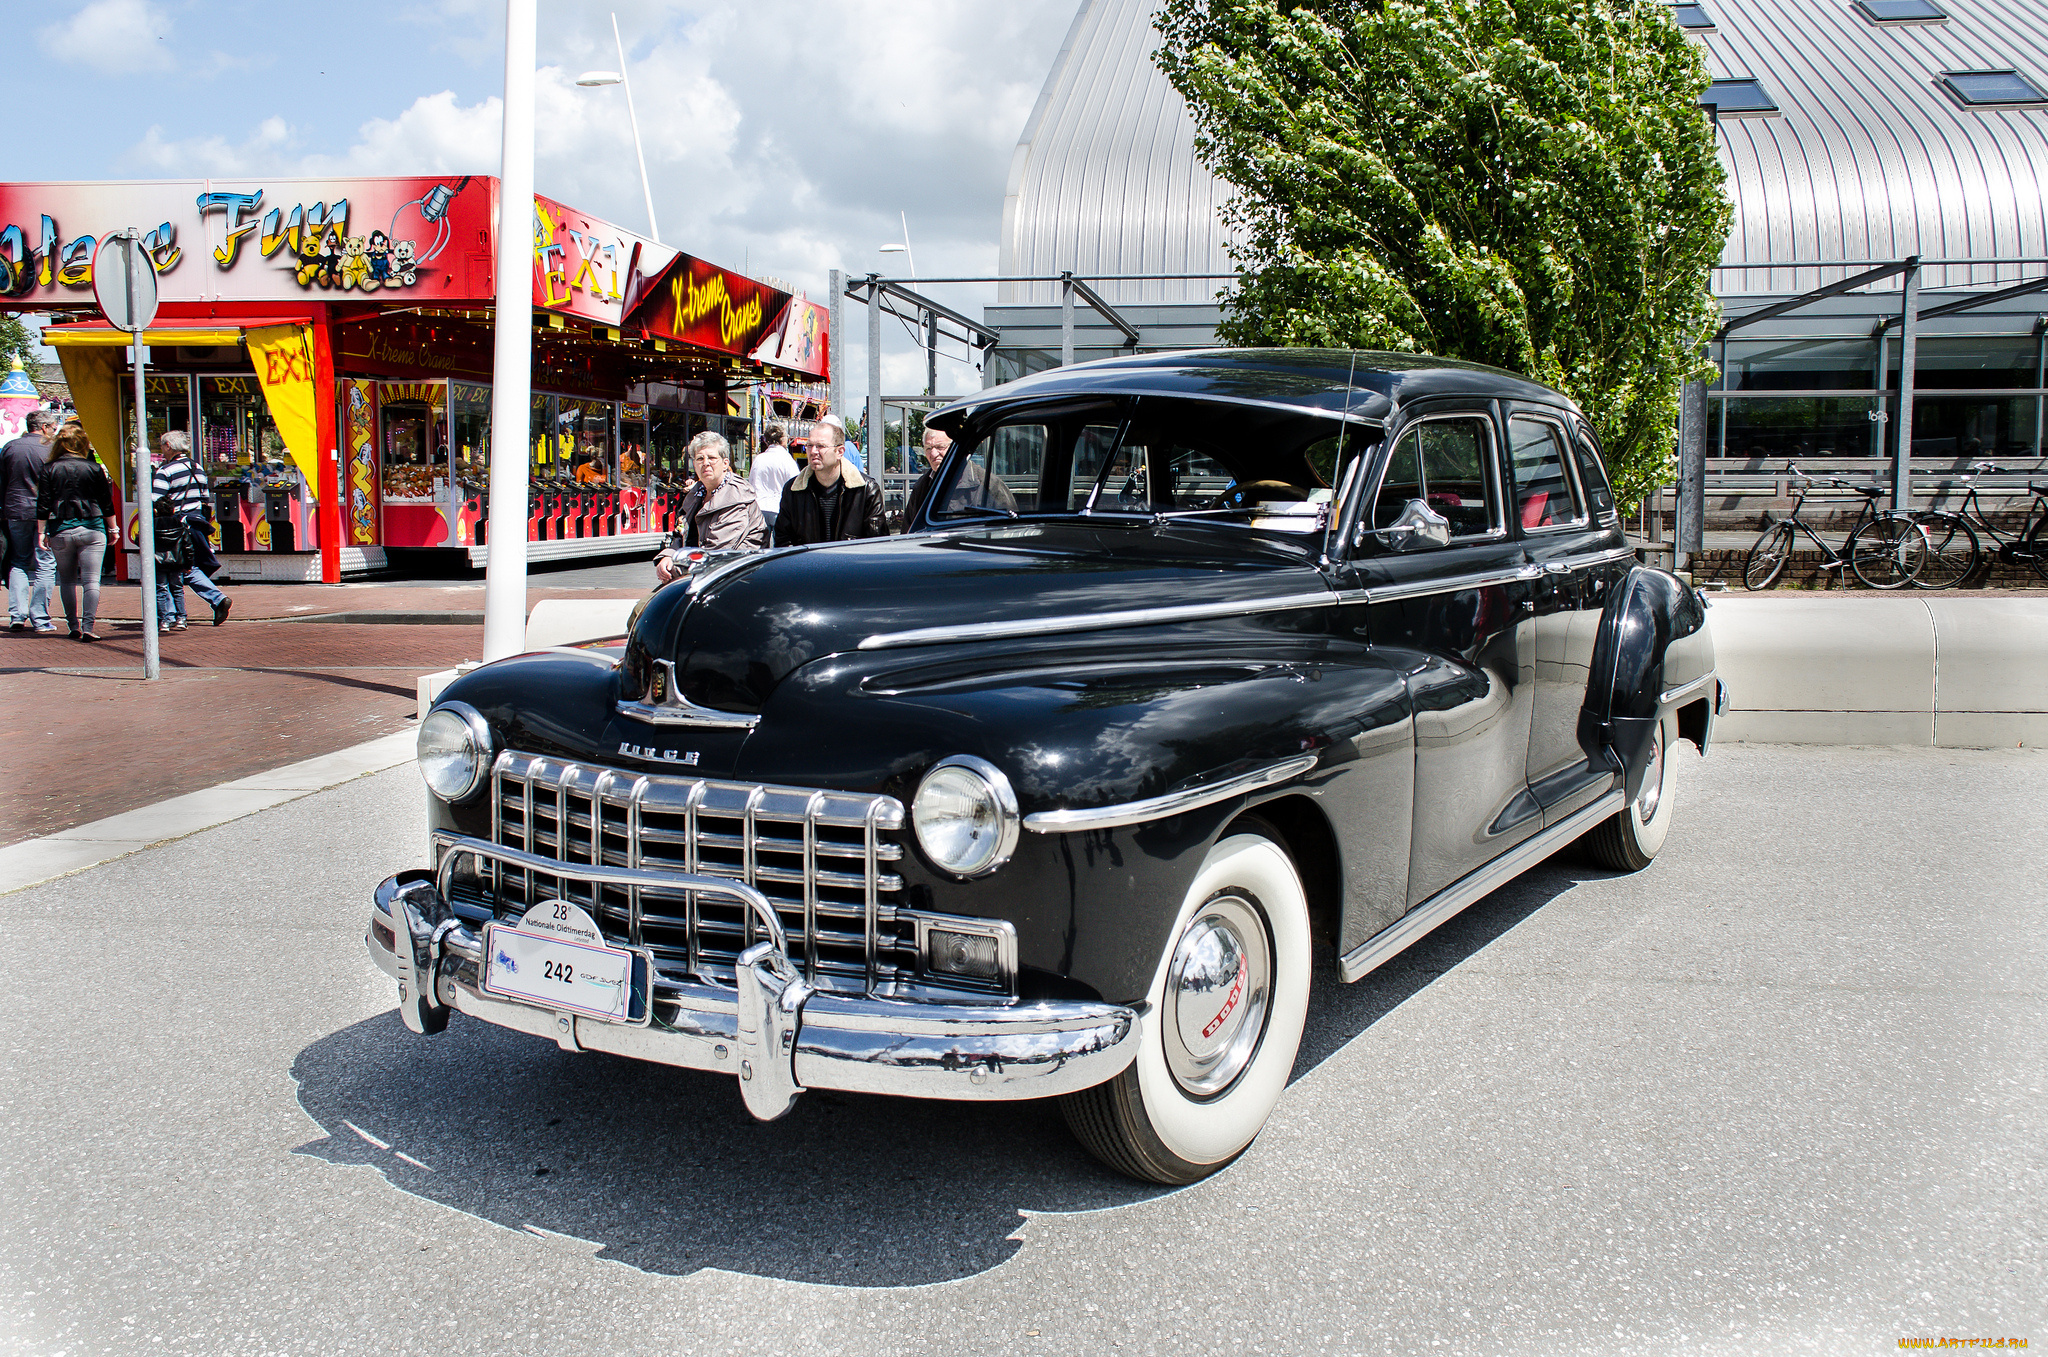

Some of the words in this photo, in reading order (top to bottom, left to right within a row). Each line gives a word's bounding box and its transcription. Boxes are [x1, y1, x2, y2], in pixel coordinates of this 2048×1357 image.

[196, 188, 348, 265] Fun
[672, 270, 725, 335] X-treme
[720, 291, 762, 346] Cranes
[369, 331, 415, 364] X-treme
[418, 342, 457, 371] Cranes
[618, 742, 701, 766] DODGE
[525, 917, 555, 931] Nationale
[556, 923, 596, 940] Oldtimerdag
[543, 960, 573, 984] 242
